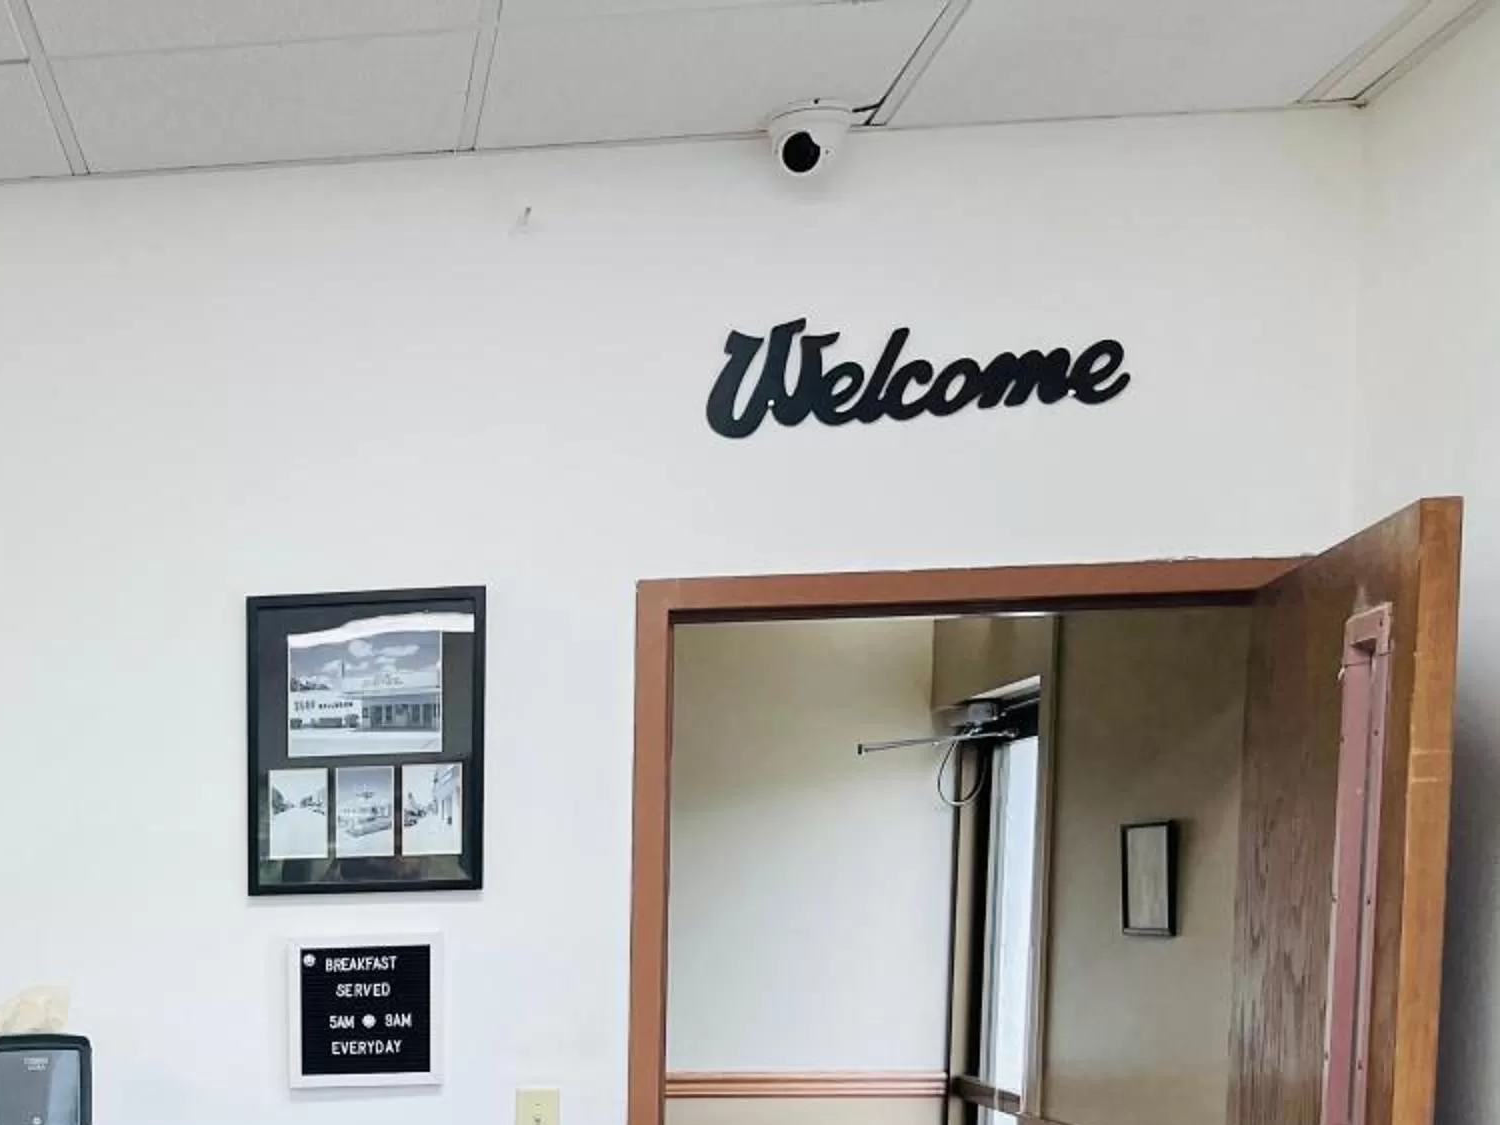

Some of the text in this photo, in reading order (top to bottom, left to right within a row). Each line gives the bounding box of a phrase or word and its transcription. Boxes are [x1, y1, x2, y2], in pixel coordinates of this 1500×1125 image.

[706, 317, 1131, 439] Welcome
[325, 955, 398, 972] BREAKFAST
[335, 982, 391, 998] SERVED
[329, 1015, 355, 1029] 5AM
[331, 1039, 402, 1055] EVERYDAY
